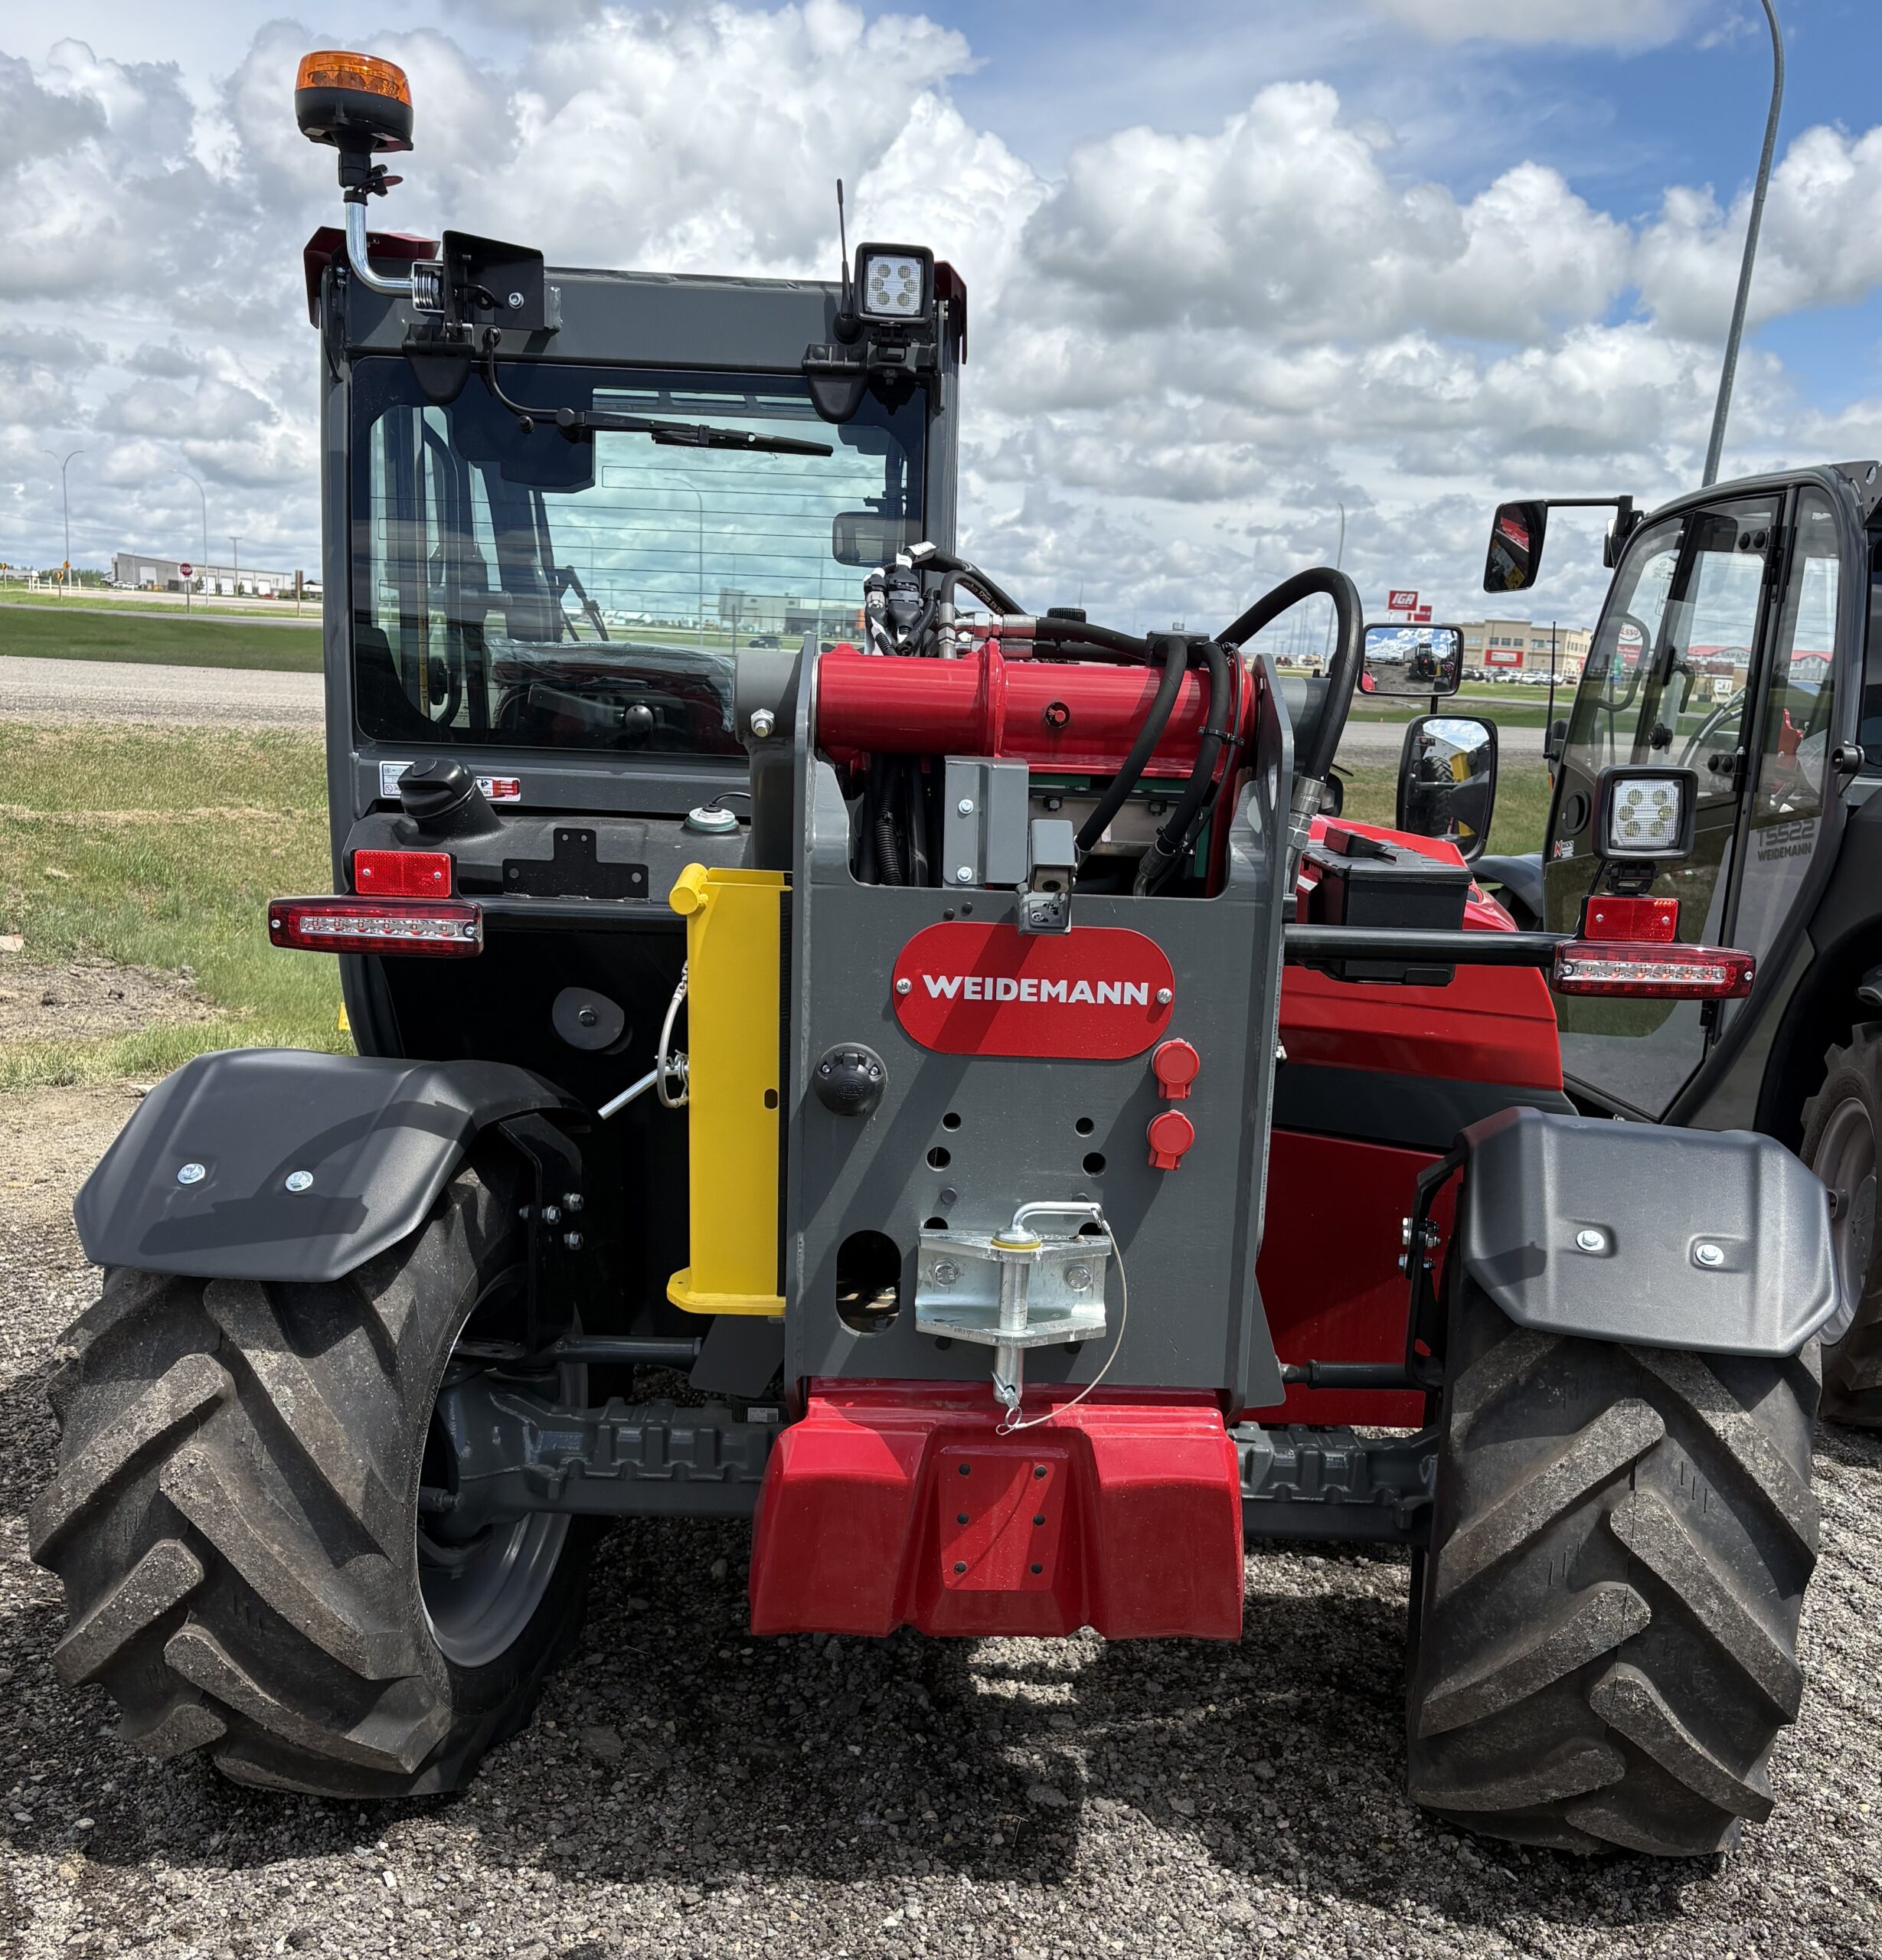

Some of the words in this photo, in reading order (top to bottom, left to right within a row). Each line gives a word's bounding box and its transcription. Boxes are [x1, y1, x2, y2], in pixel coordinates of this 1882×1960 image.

[1391, 593, 1416, 605] IGA
[1756, 819, 1815, 847] T5522
[1757, 843, 1813, 861] WEIDEMANN
[922, 974, 1149, 1006] WEIDEMANN
